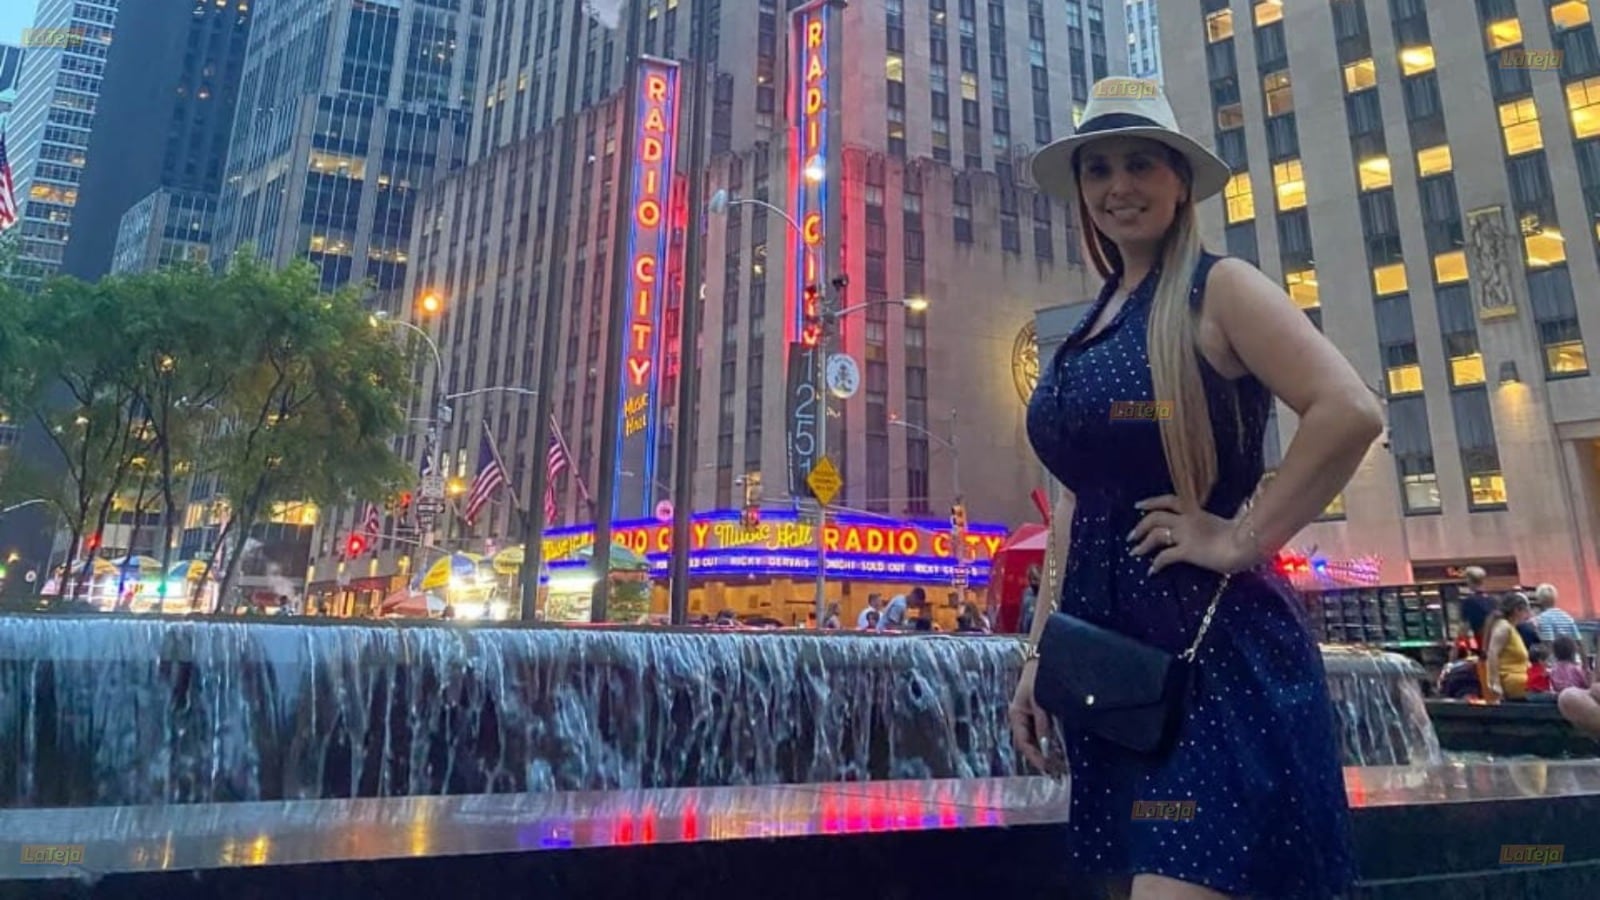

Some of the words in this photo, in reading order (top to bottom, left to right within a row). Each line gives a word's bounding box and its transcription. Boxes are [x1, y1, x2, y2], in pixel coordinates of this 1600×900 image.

[637, 75, 667, 227] RADIO
[628, 256, 656, 386] CITY
[766, 522, 813, 550] Hall
[823, 527, 918, 555] RADIO
[934, 533, 1000, 560] CTY
